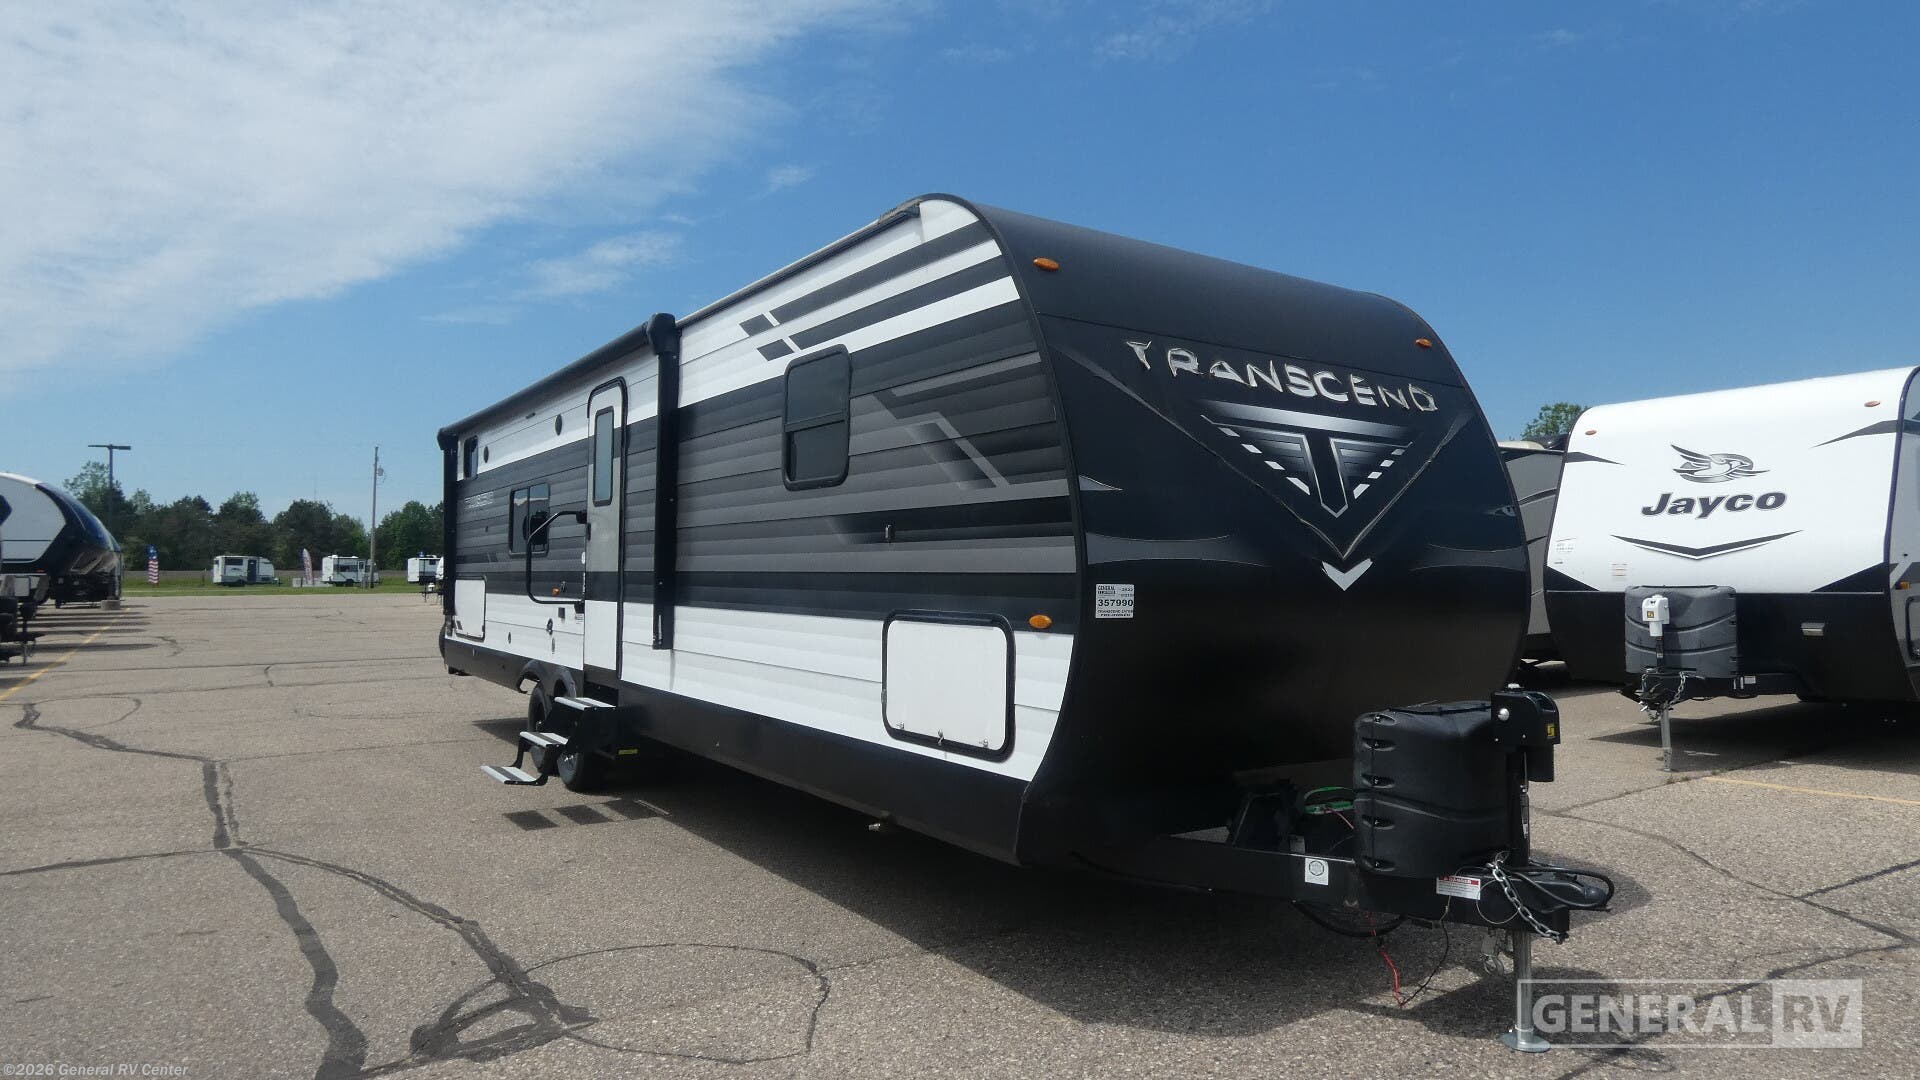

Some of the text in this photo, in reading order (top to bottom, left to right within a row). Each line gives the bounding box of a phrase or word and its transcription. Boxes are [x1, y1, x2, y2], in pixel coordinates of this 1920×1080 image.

[1126, 340, 1438, 412] TRANSCEND
[1641, 491, 1788, 520] Jayco
[1098, 599, 1134, 607] 357990
